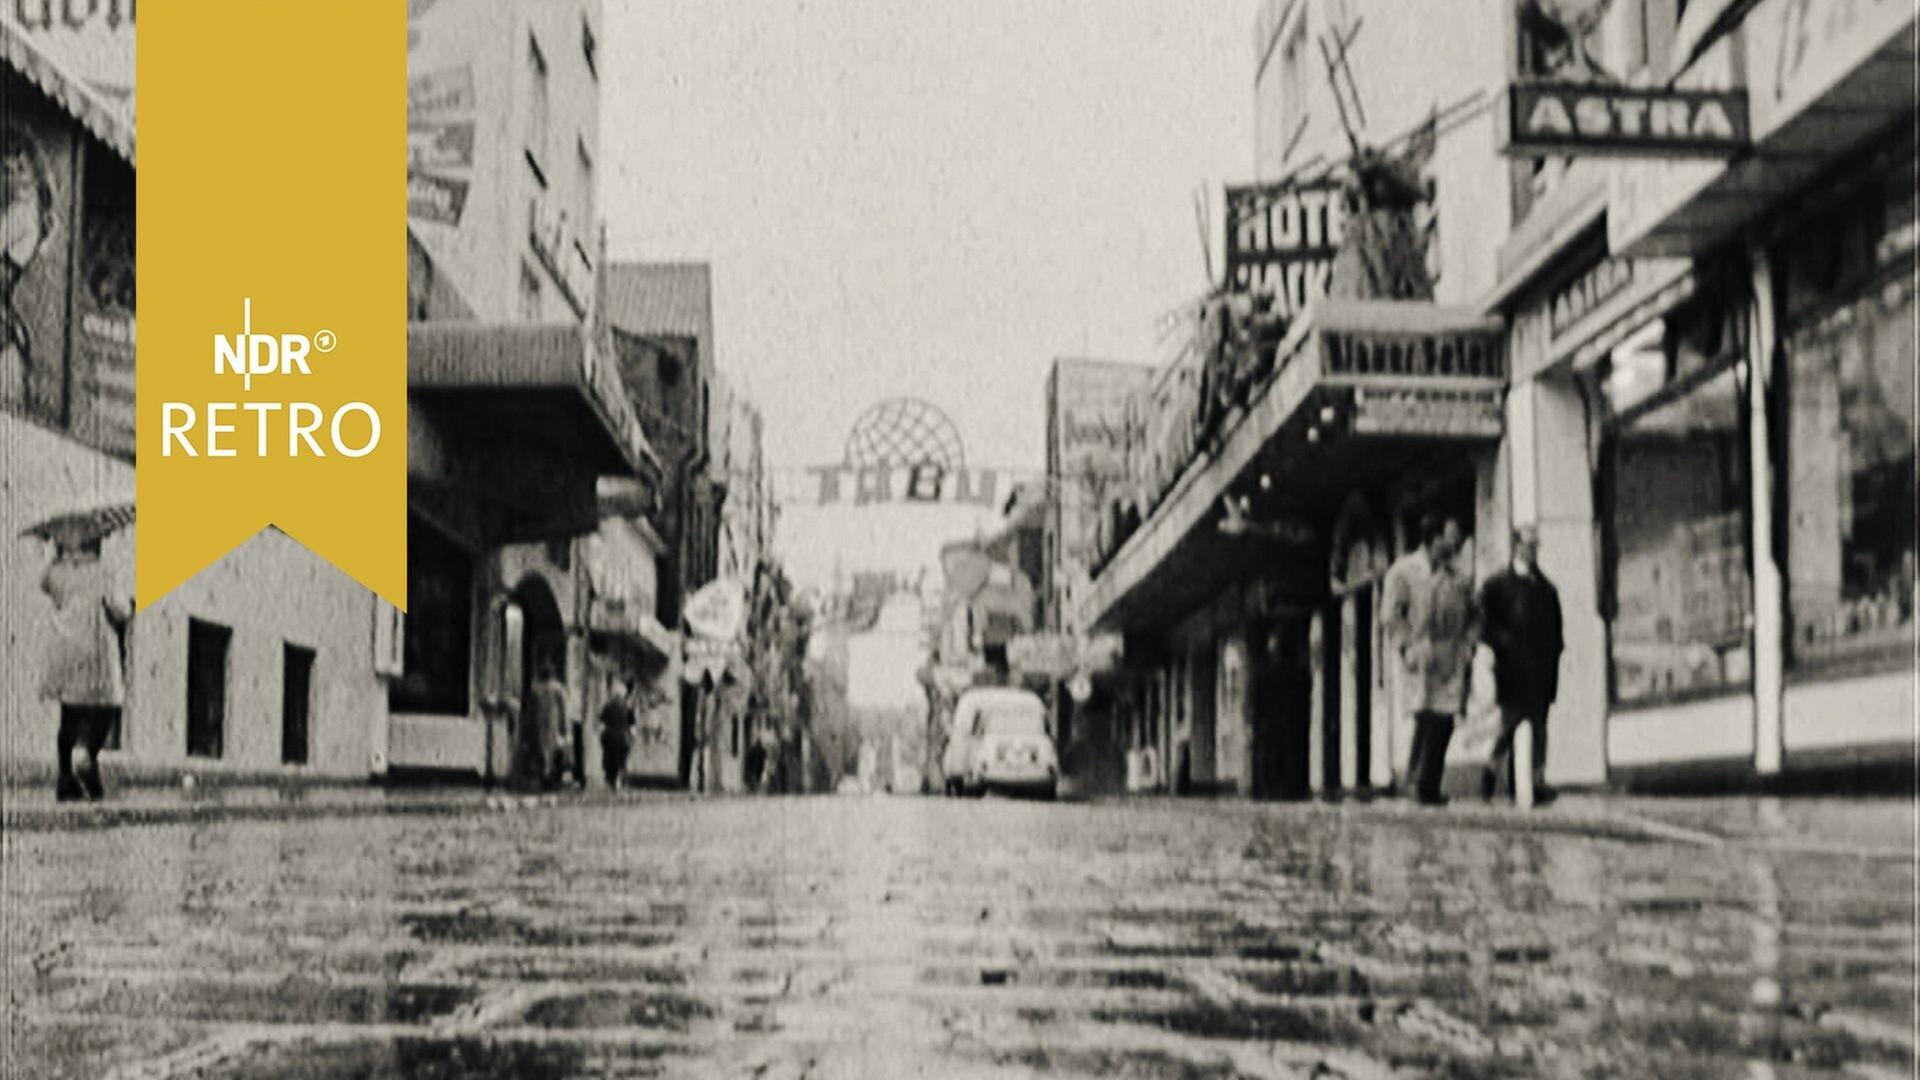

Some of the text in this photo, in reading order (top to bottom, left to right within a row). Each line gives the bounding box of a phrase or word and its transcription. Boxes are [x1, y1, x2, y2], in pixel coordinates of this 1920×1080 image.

[1529, 96, 1733, 137] ASTRA
[1237, 189, 1344, 251] HOTE
[806, 463, 997, 506] TABU
